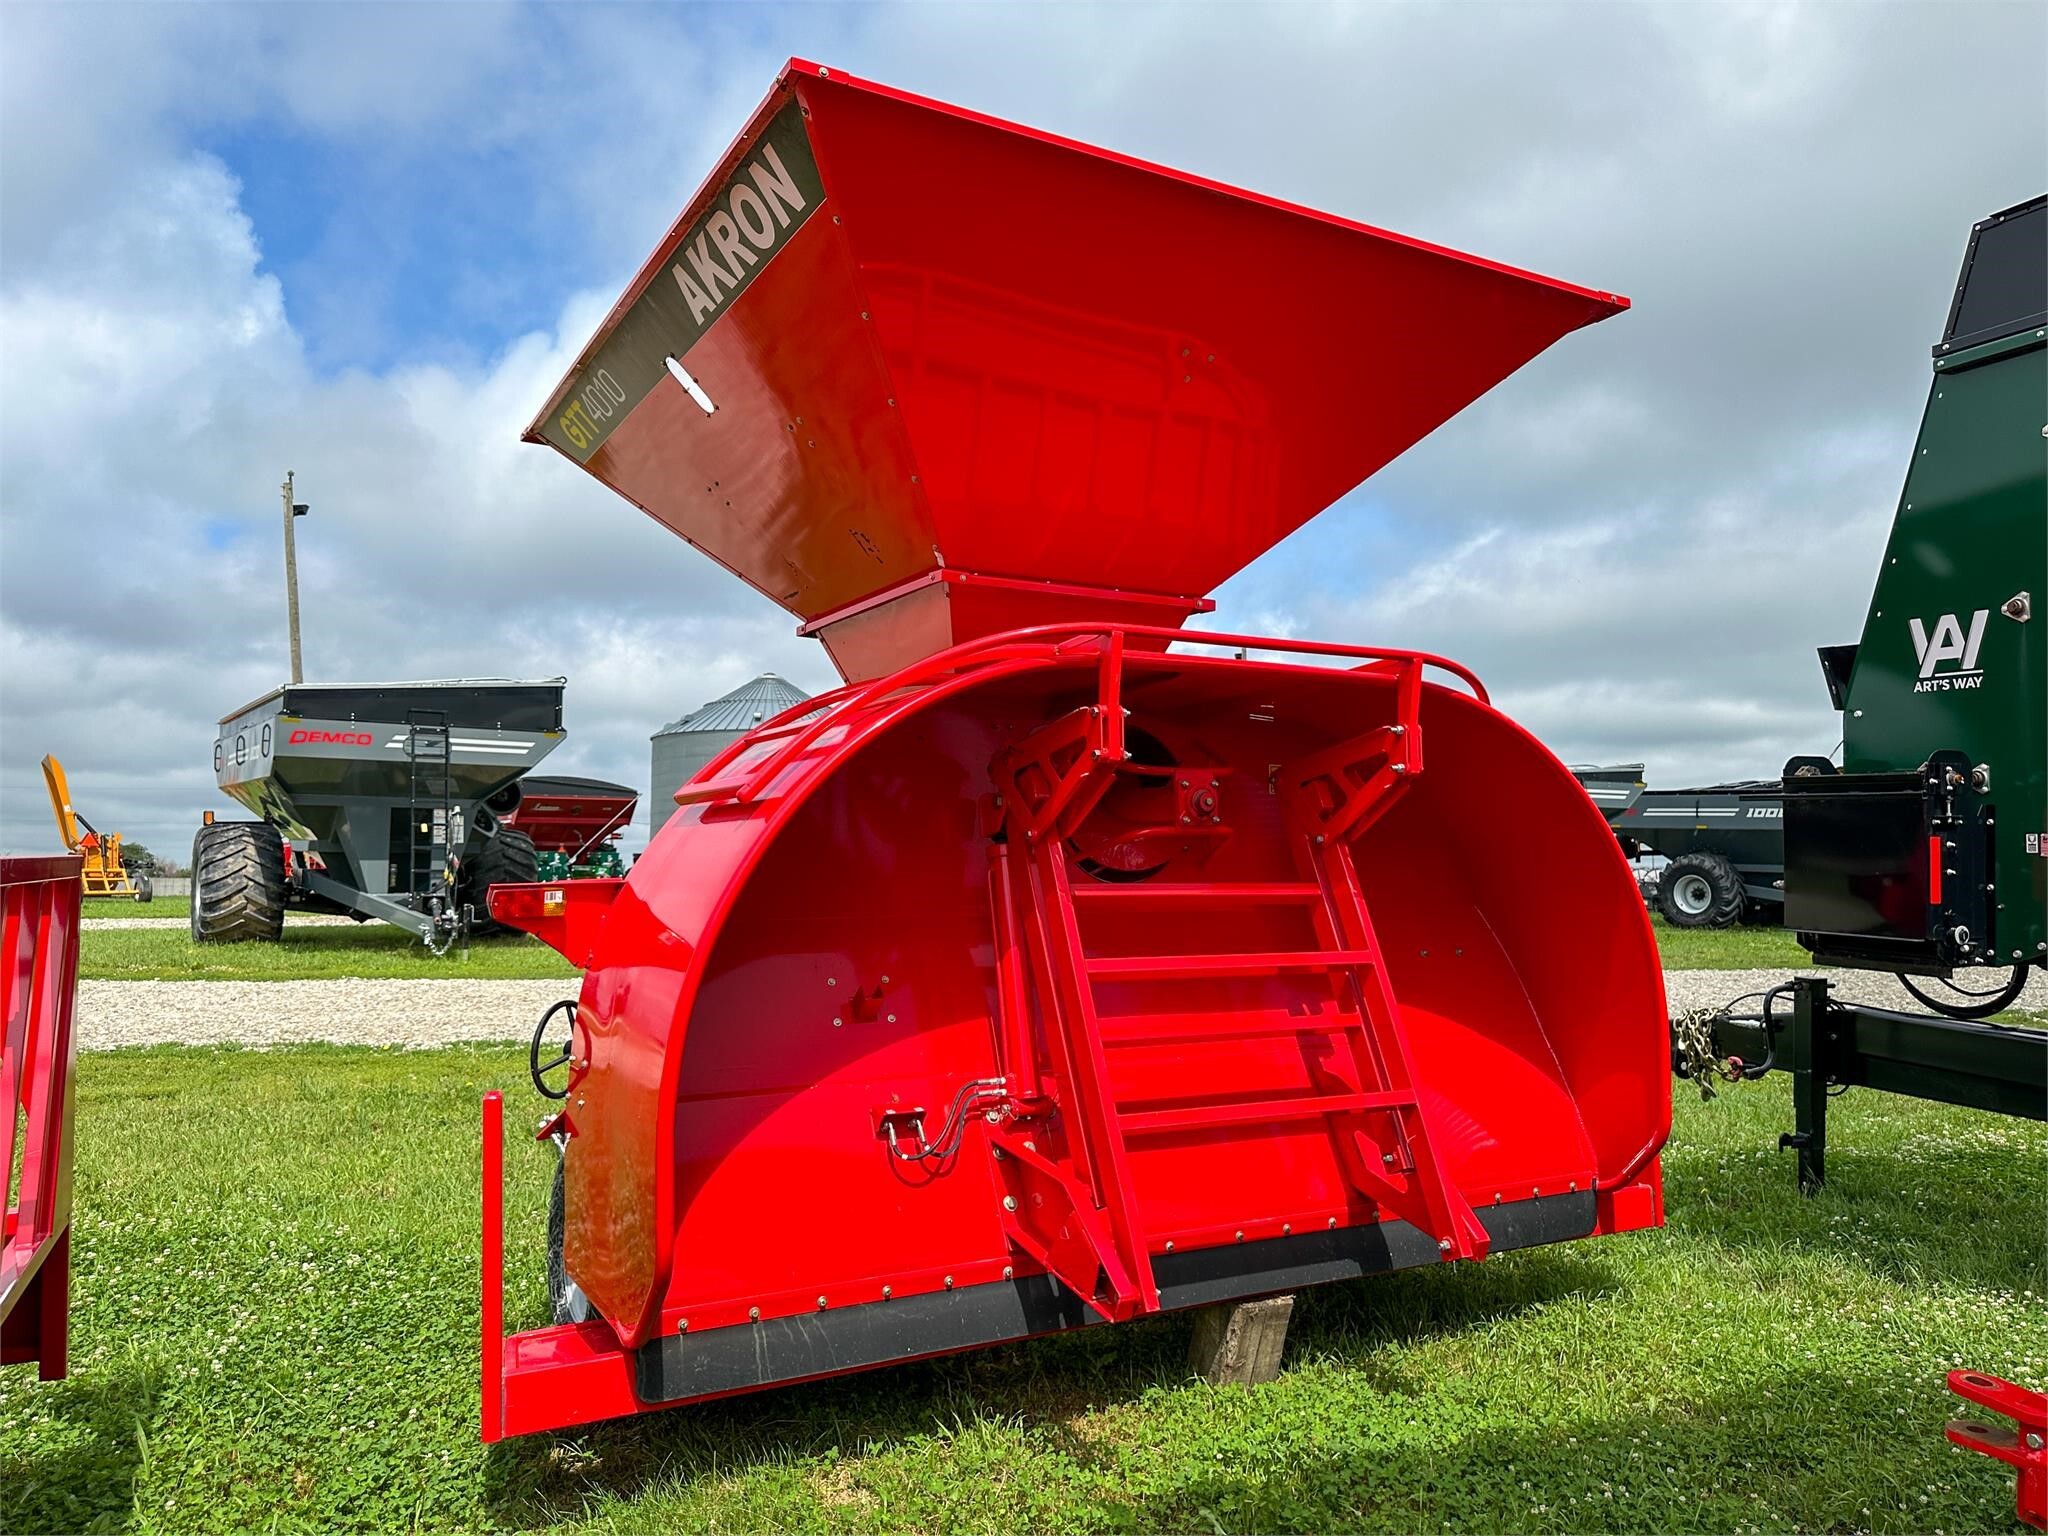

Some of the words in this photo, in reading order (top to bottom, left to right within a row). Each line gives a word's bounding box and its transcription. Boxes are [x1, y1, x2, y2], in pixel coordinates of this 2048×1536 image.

[671, 142, 807, 327] AKRON
[1913, 679, 1951, 693] ART'S
[1952, 675, 1983, 690] WAY
[288, 729, 373, 746] DEMCO
